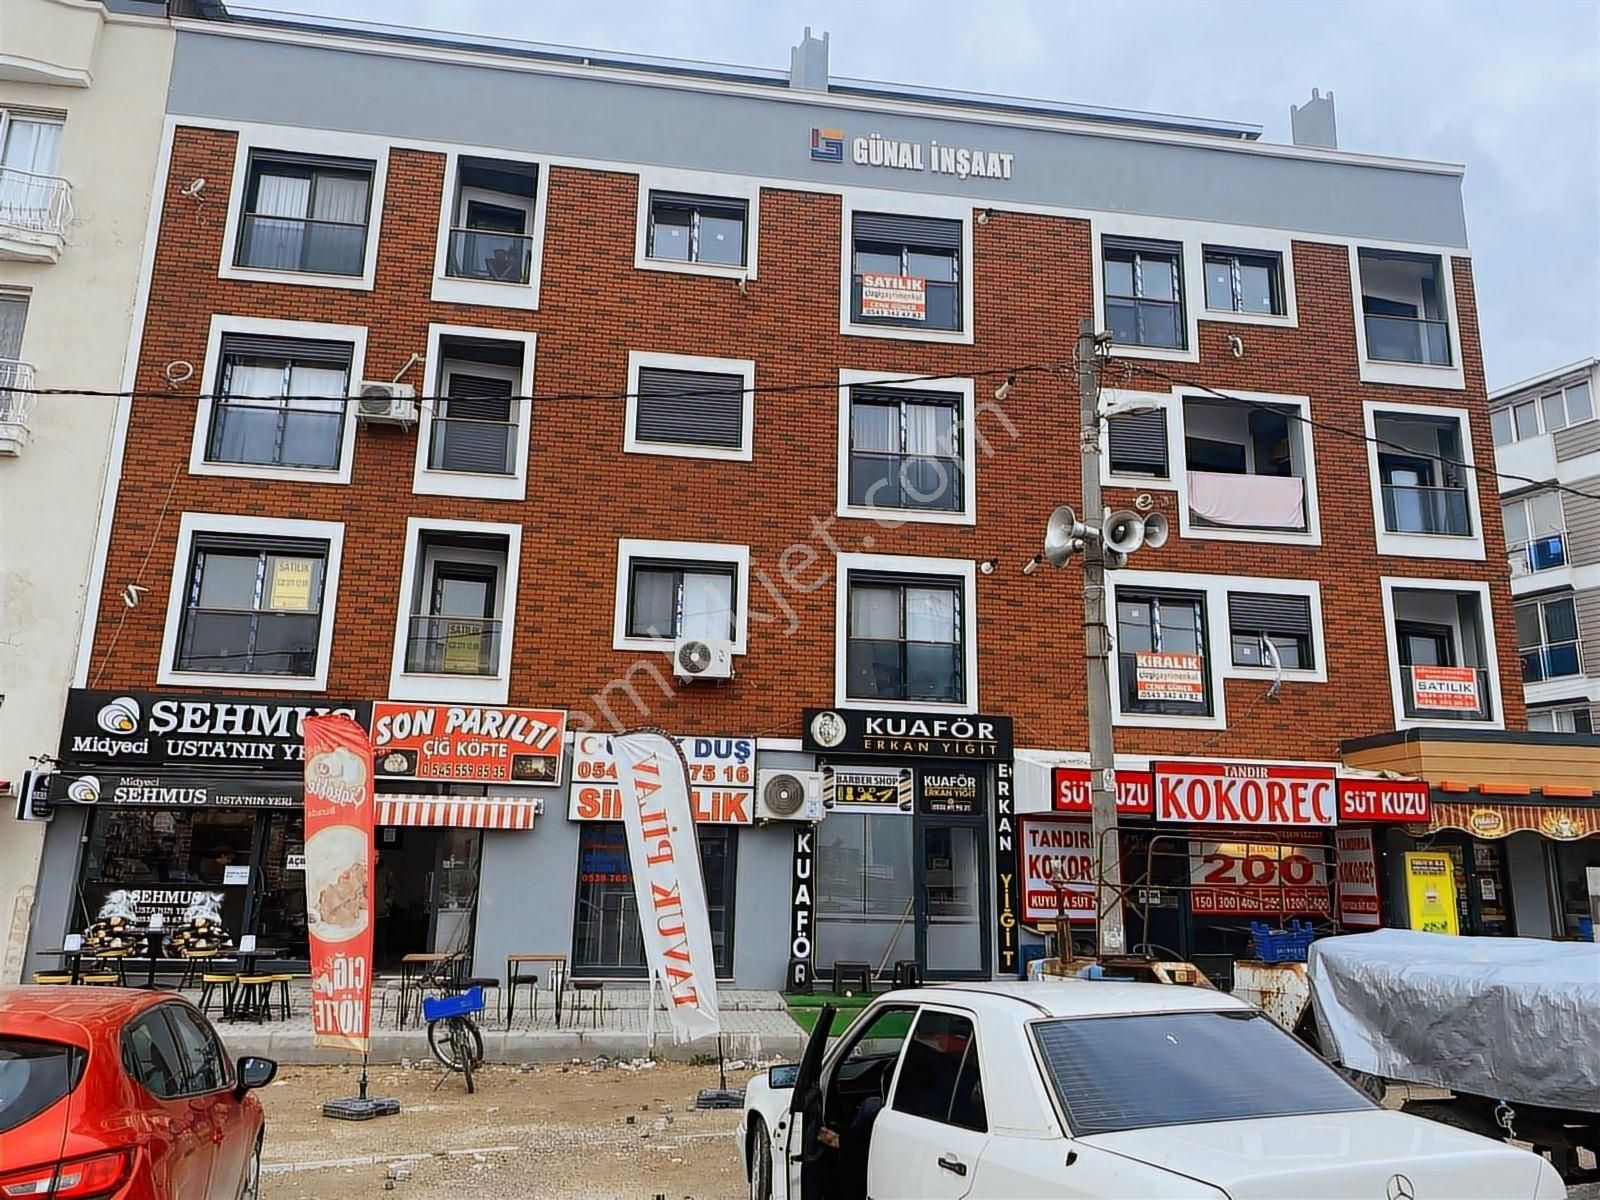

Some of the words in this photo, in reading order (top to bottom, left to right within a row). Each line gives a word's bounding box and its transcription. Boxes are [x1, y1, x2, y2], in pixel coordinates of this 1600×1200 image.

[852, 133, 924, 170] GÜNAL
[930, 140, 1014, 179] İNŞAAT
[863, 275, 923, 290] SATILIK
[1136, 655, 1198, 669] KİRALIK
[1418, 682, 1472, 692] SATILIK
[149, 700, 356, 737] ŞEHMU
[376, 709, 436, 745] SON
[445, 707, 557, 750] PARILTI
[866, 717, 994, 740] KUAFÖR
[72, 736, 149, 757] Midyeci
[167, 740, 278, 760] USTA'NIN
[423, 737, 450, 759] ÇİĞ
[457, 738, 508, 758] KÖFTE
[694, 739, 751, 763] DUŞ
[864, 739, 929, 752] ERKAN
[942, 741, 998, 755] YİĞİT
[422, 763, 428, 775] 0
[432, 764, 450, 776] 545
[578, 762, 617, 779] 054
[723, 766, 749, 782] 16
[1224, 765, 1269, 778] TANDIR
[119, 777, 160, 788] Midyeci
[836, 776, 873, 785] BARBER
[874, 776, 899, 785] SHOP
[924, 773, 976, 787] KUAFÖR
[113, 787, 207, 805] ŞEHMUS
[1115, 782, 1149, 806] UZU
[1344, 790, 1376, 815] SÜT
[1380, 792, 1426, 815] KUZU
[998, 763, 1012, 850] ERKAN
[1203, 854, 1314, 885] 200
[1195, 896, 1212, 909] 150
[1218, 897, 1236, 909] 300
[1000, 873, 1015, 966] YİĞİT
